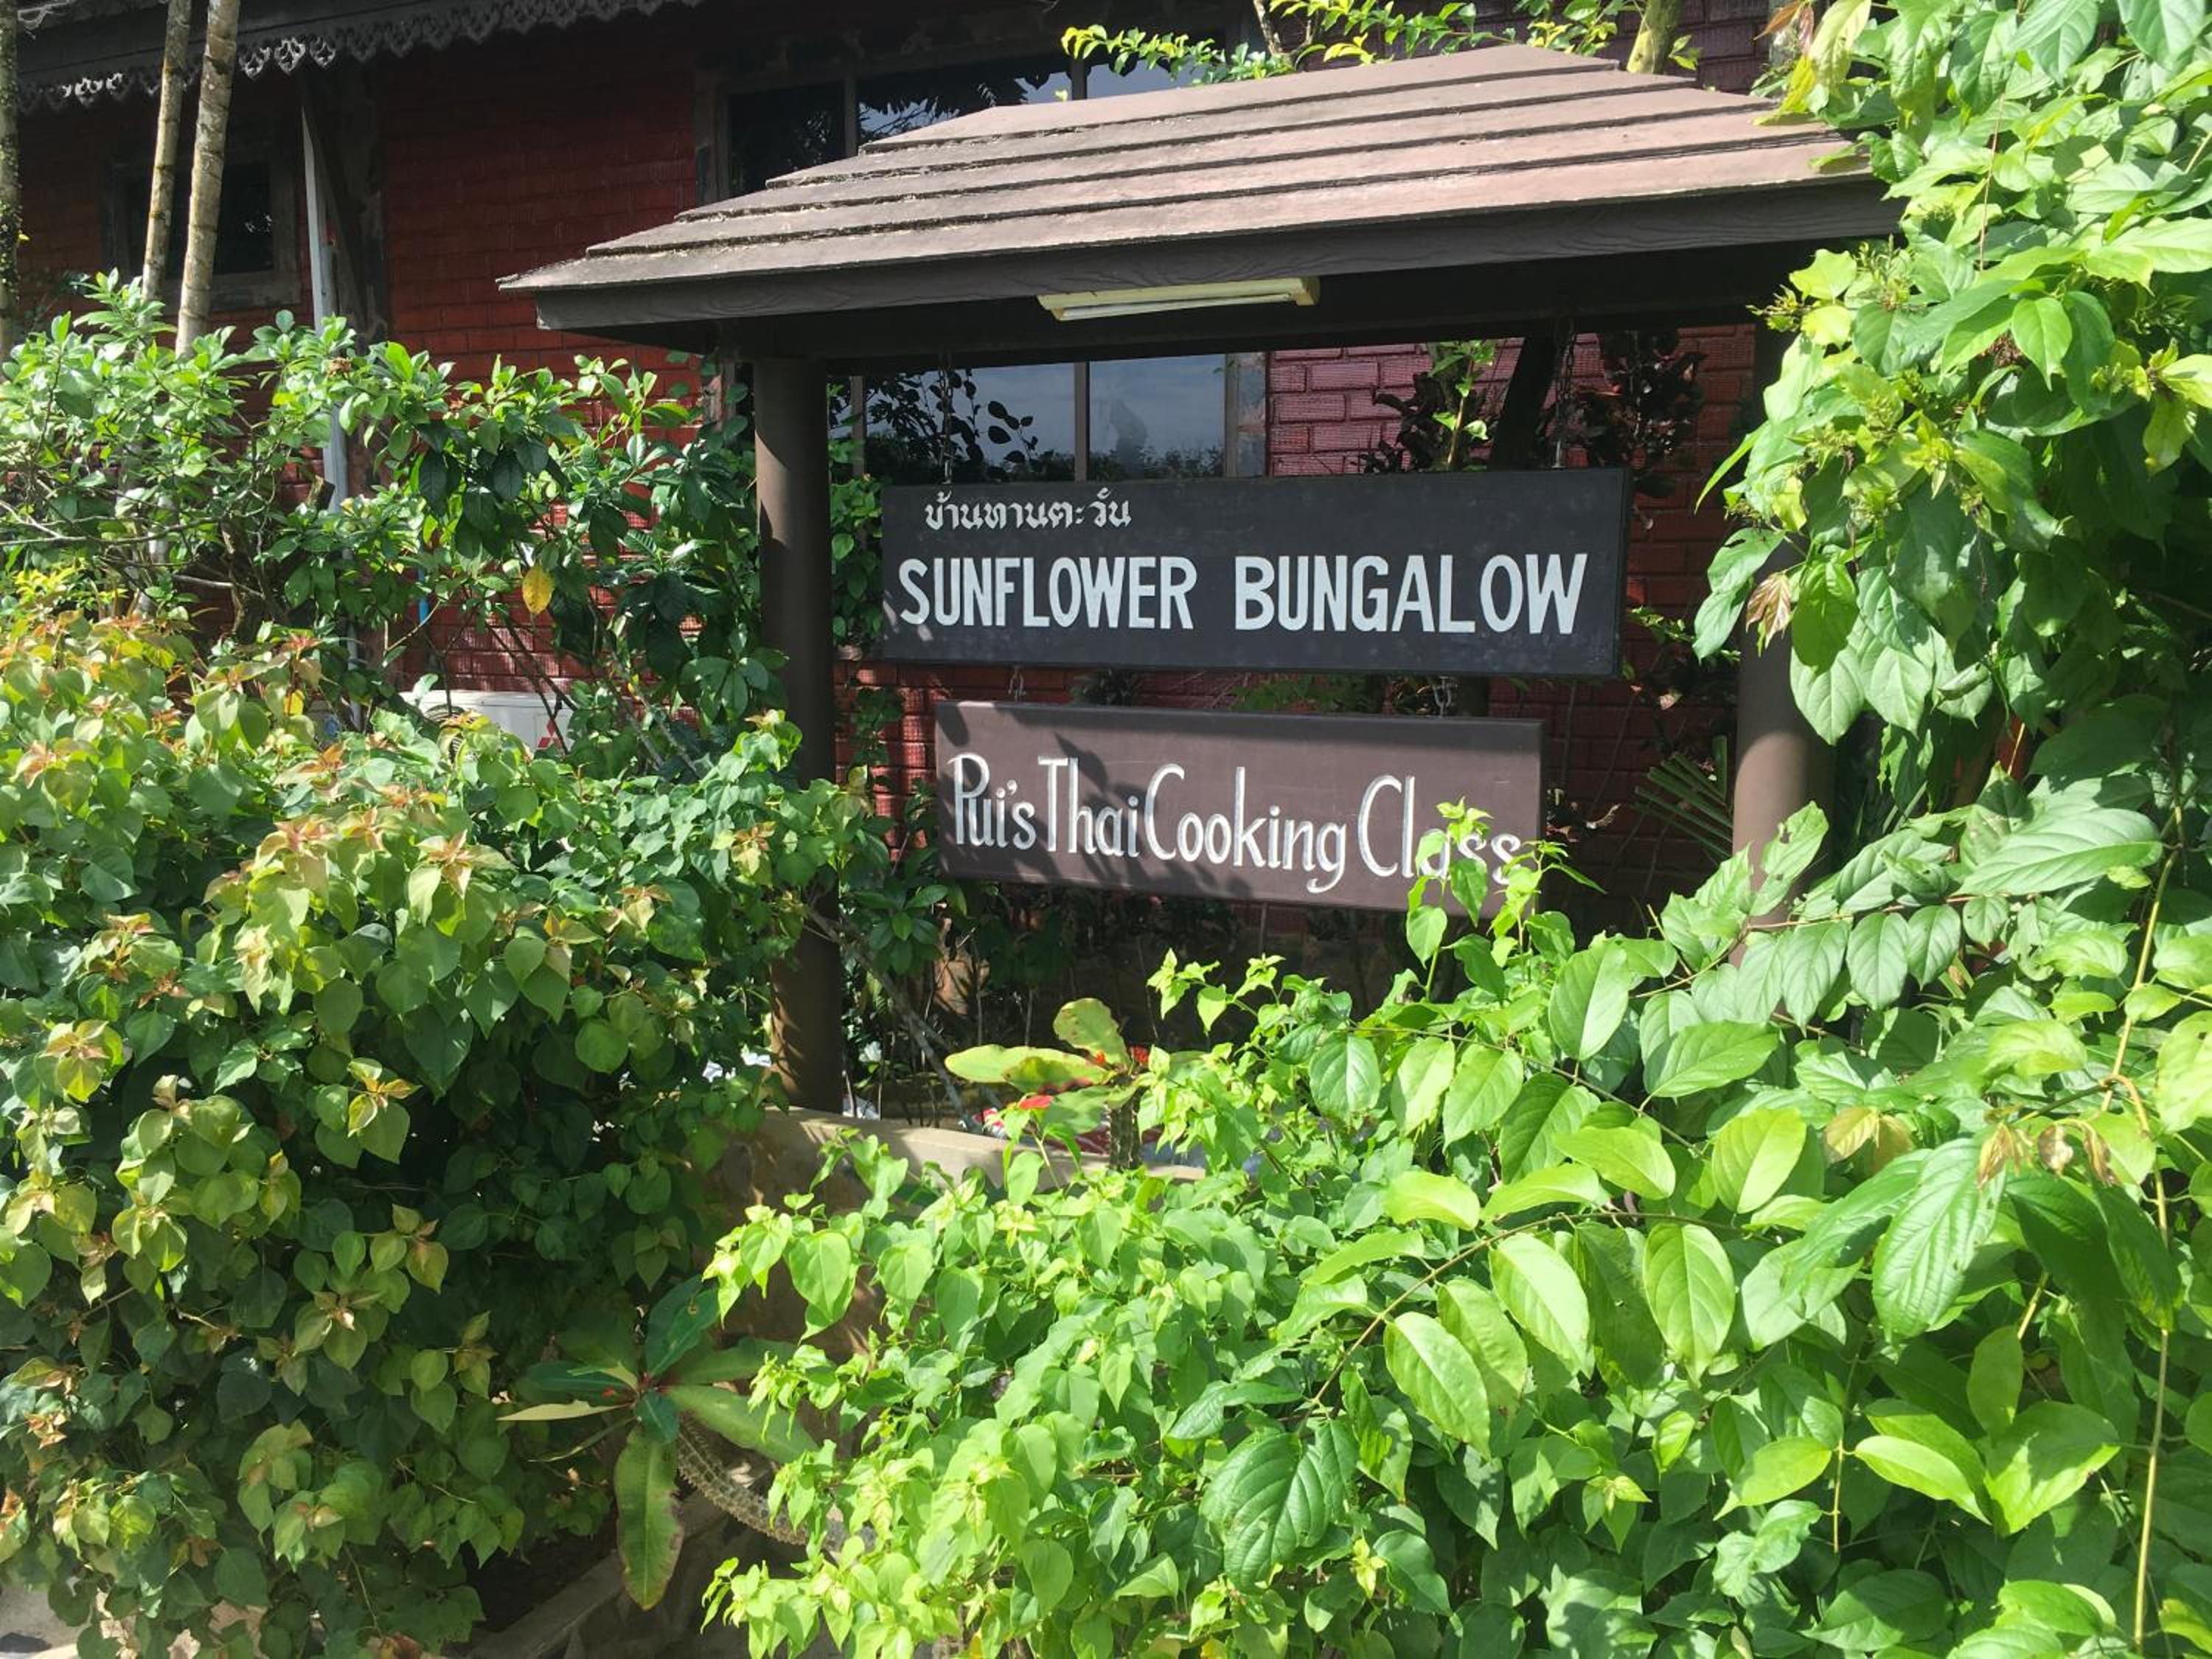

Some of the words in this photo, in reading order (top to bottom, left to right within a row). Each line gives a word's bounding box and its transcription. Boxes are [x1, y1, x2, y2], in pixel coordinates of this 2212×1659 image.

[898, 556, 1197, 629] SUNFLOWER
[1234, 553, 1588, 634] BUNGALOW
[947, 752, 1037, 849] Pui's
[1037, 755, 1139, 858] Thai
[1144, 763, 1347, 894] Cooking
